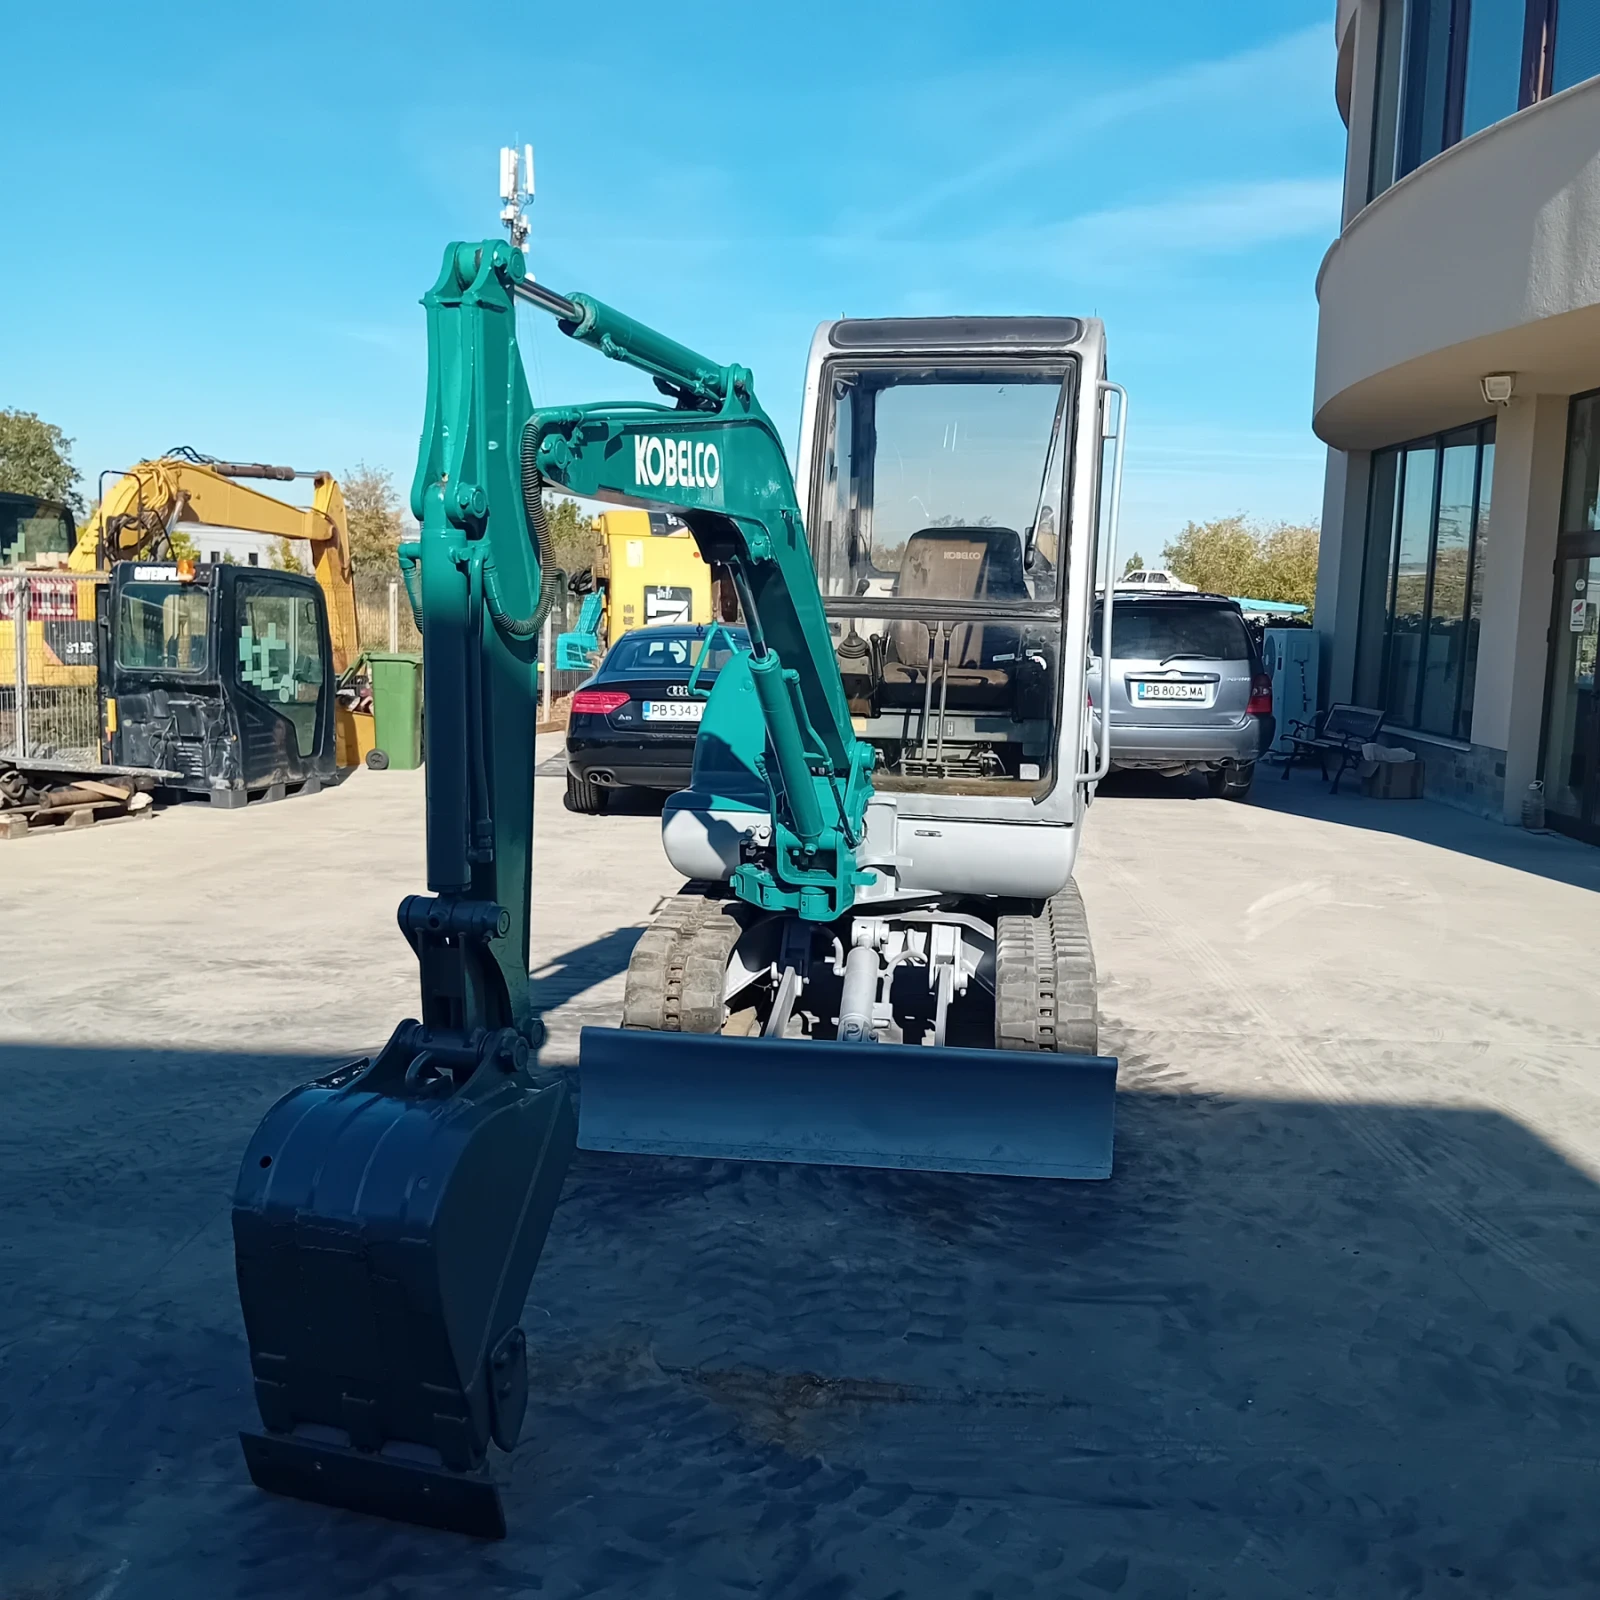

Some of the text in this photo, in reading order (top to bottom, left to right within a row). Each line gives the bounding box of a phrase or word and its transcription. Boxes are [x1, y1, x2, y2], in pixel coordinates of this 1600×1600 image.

[634, 434, 720, 488] KOBELCO
[943, 551, 981, 560] KOBELCO
[1146, 685, 1203, 697] PB 8025 MA
[651, 704, 667, 716] PB
[669, 704, 699, 716] 5343
